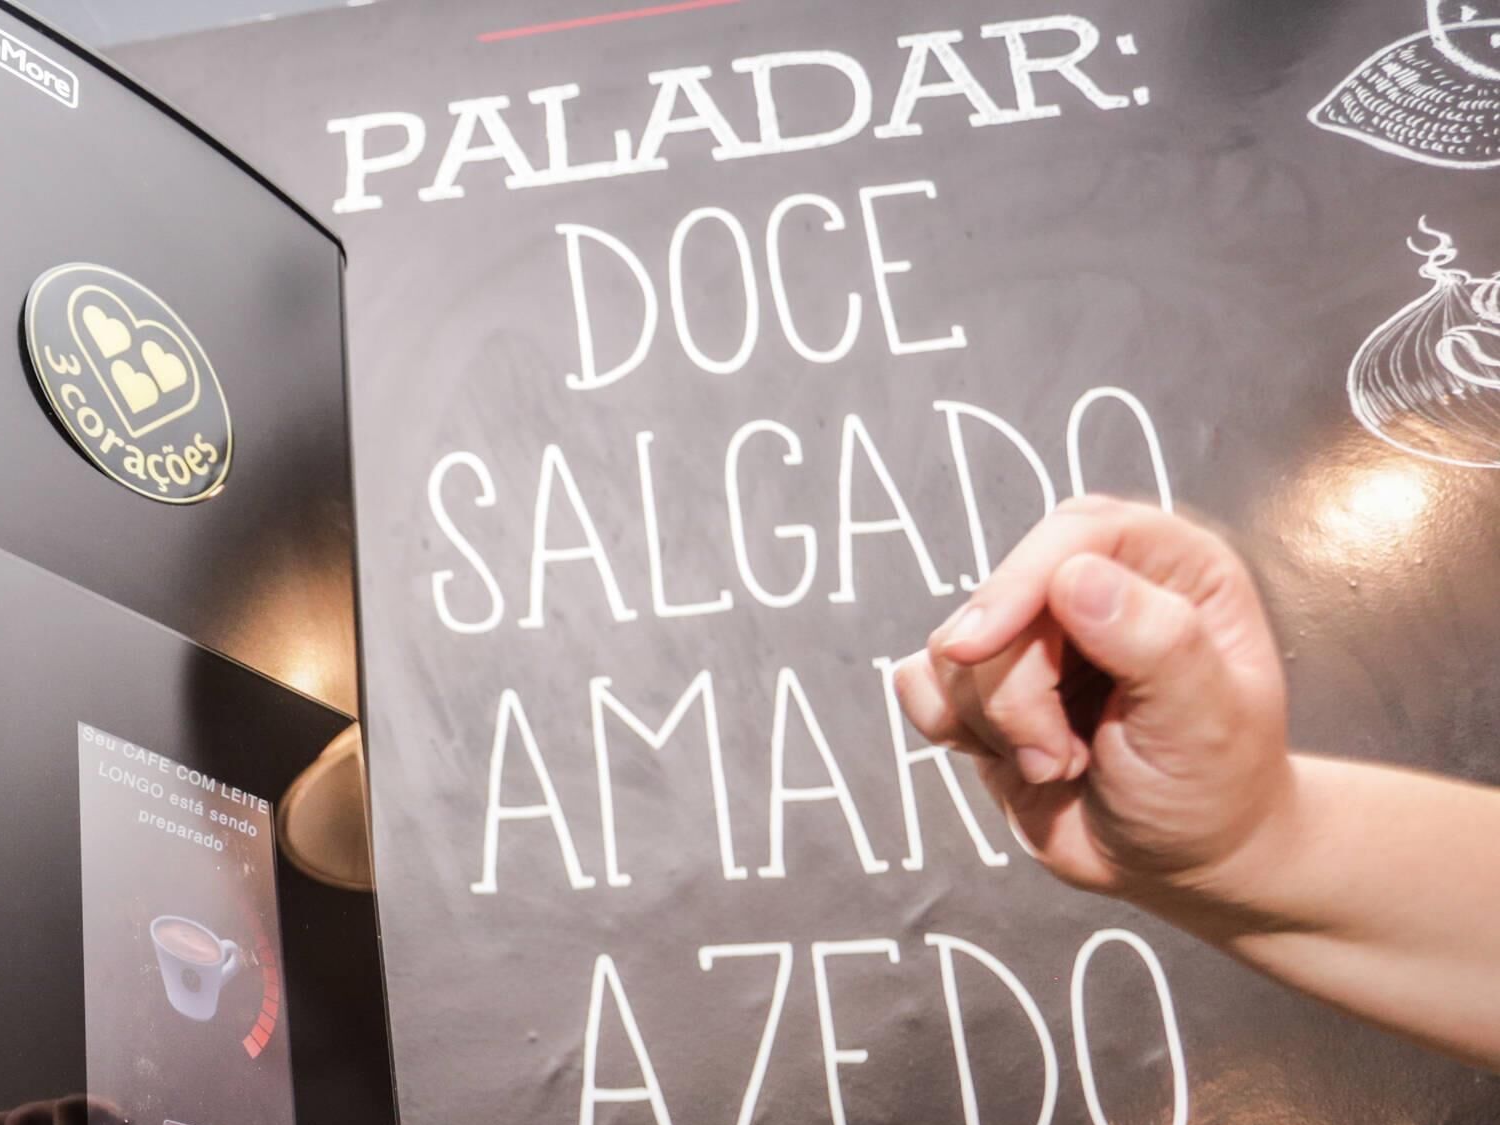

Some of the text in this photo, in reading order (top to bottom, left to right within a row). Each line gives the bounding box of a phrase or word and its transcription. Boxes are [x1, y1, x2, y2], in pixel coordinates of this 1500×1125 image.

[327, 14, 1150, 213] PALADAR:
[555, 181, 967, 390] DOCE
[44, 345, 219, 492] 3 corações
[82, 726, 116, 751] Seu
[176, 766, 216, 793] COM
[221, 784, 269, 815] LEITE
[98, 761, 258, 837] LONGO está sendo
[138, 809, 224, 852] preparado
[470, 656, 1043, 893] AMAR
